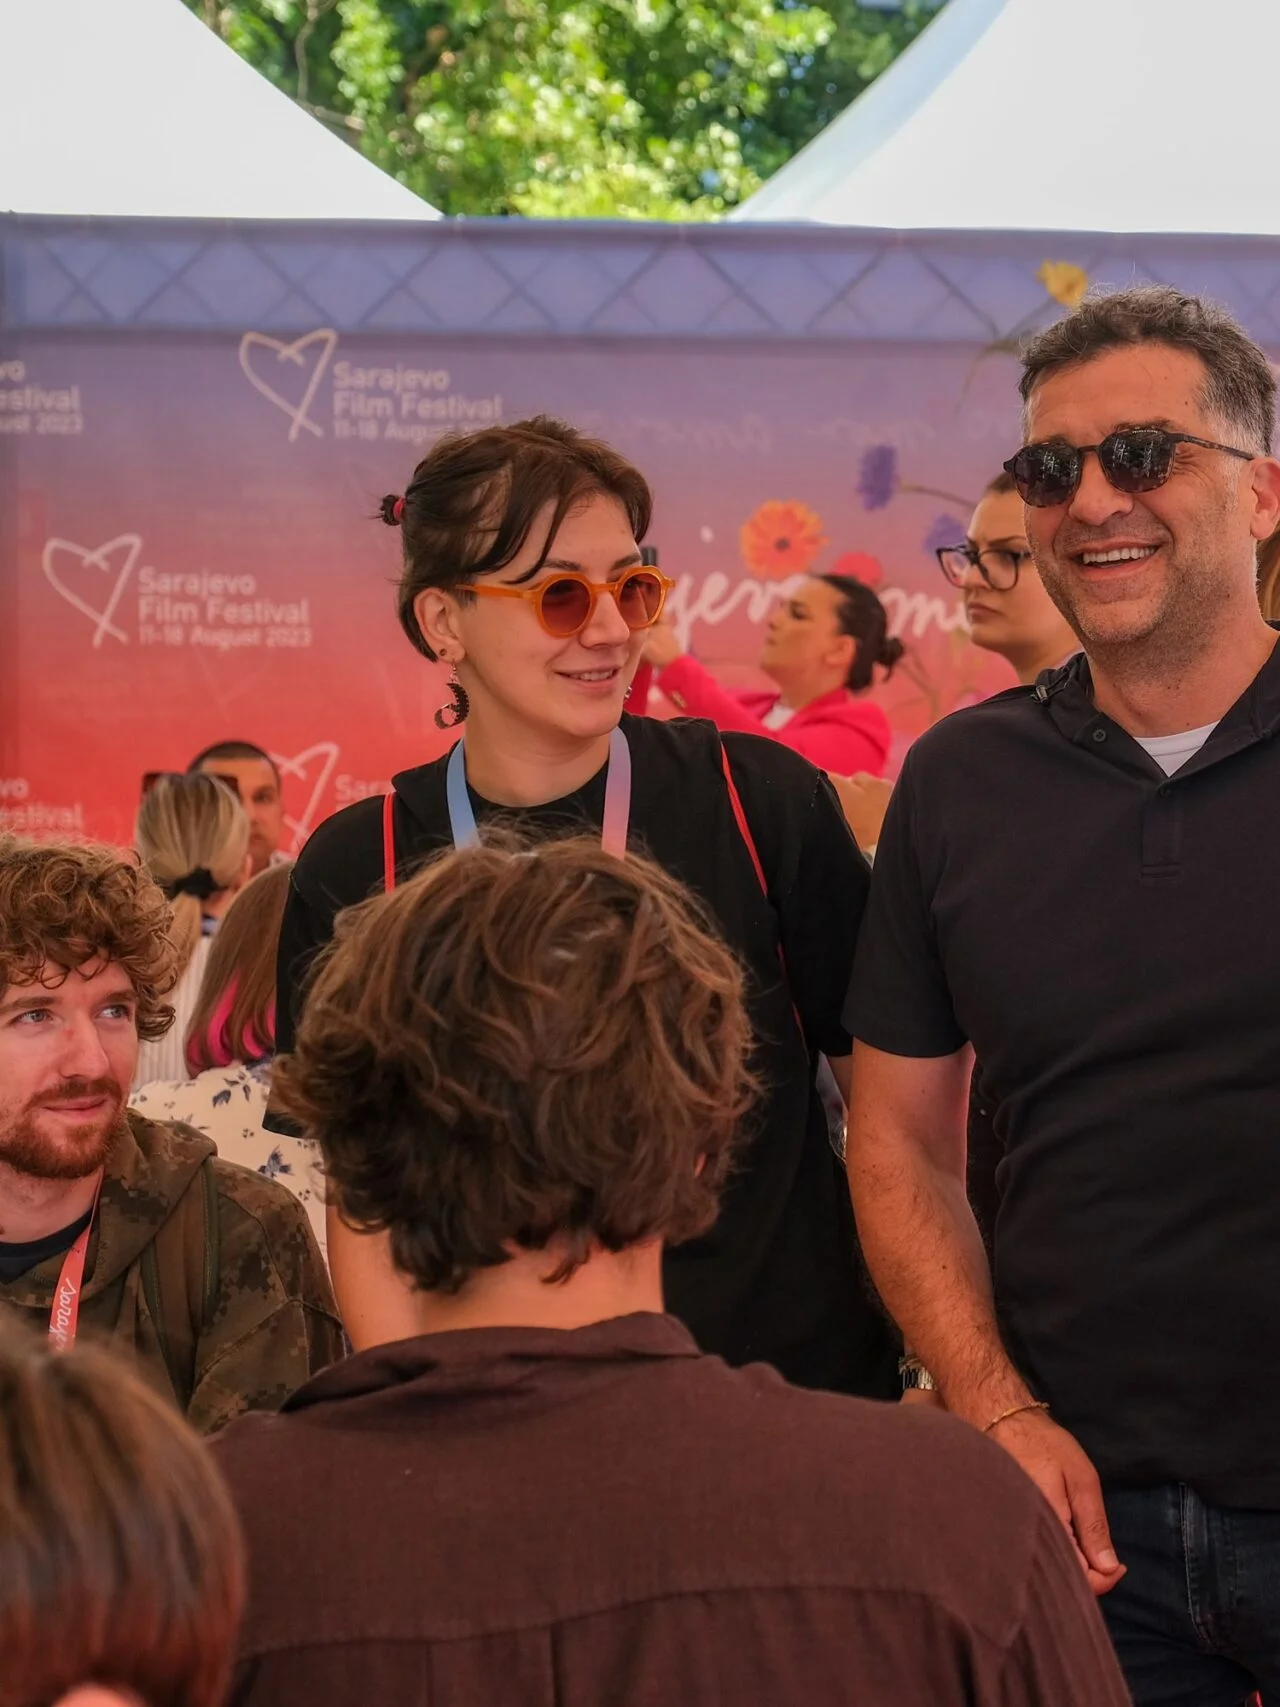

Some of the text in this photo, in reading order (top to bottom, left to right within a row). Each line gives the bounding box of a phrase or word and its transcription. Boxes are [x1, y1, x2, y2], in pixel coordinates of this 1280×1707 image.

[333, 360, 451, 396] Sarajevo
[333, 390, 502, 420] Film Festival
[137, 565, 256, 601] Sarajevo
[138, 595, 308, 625] Film Festival
